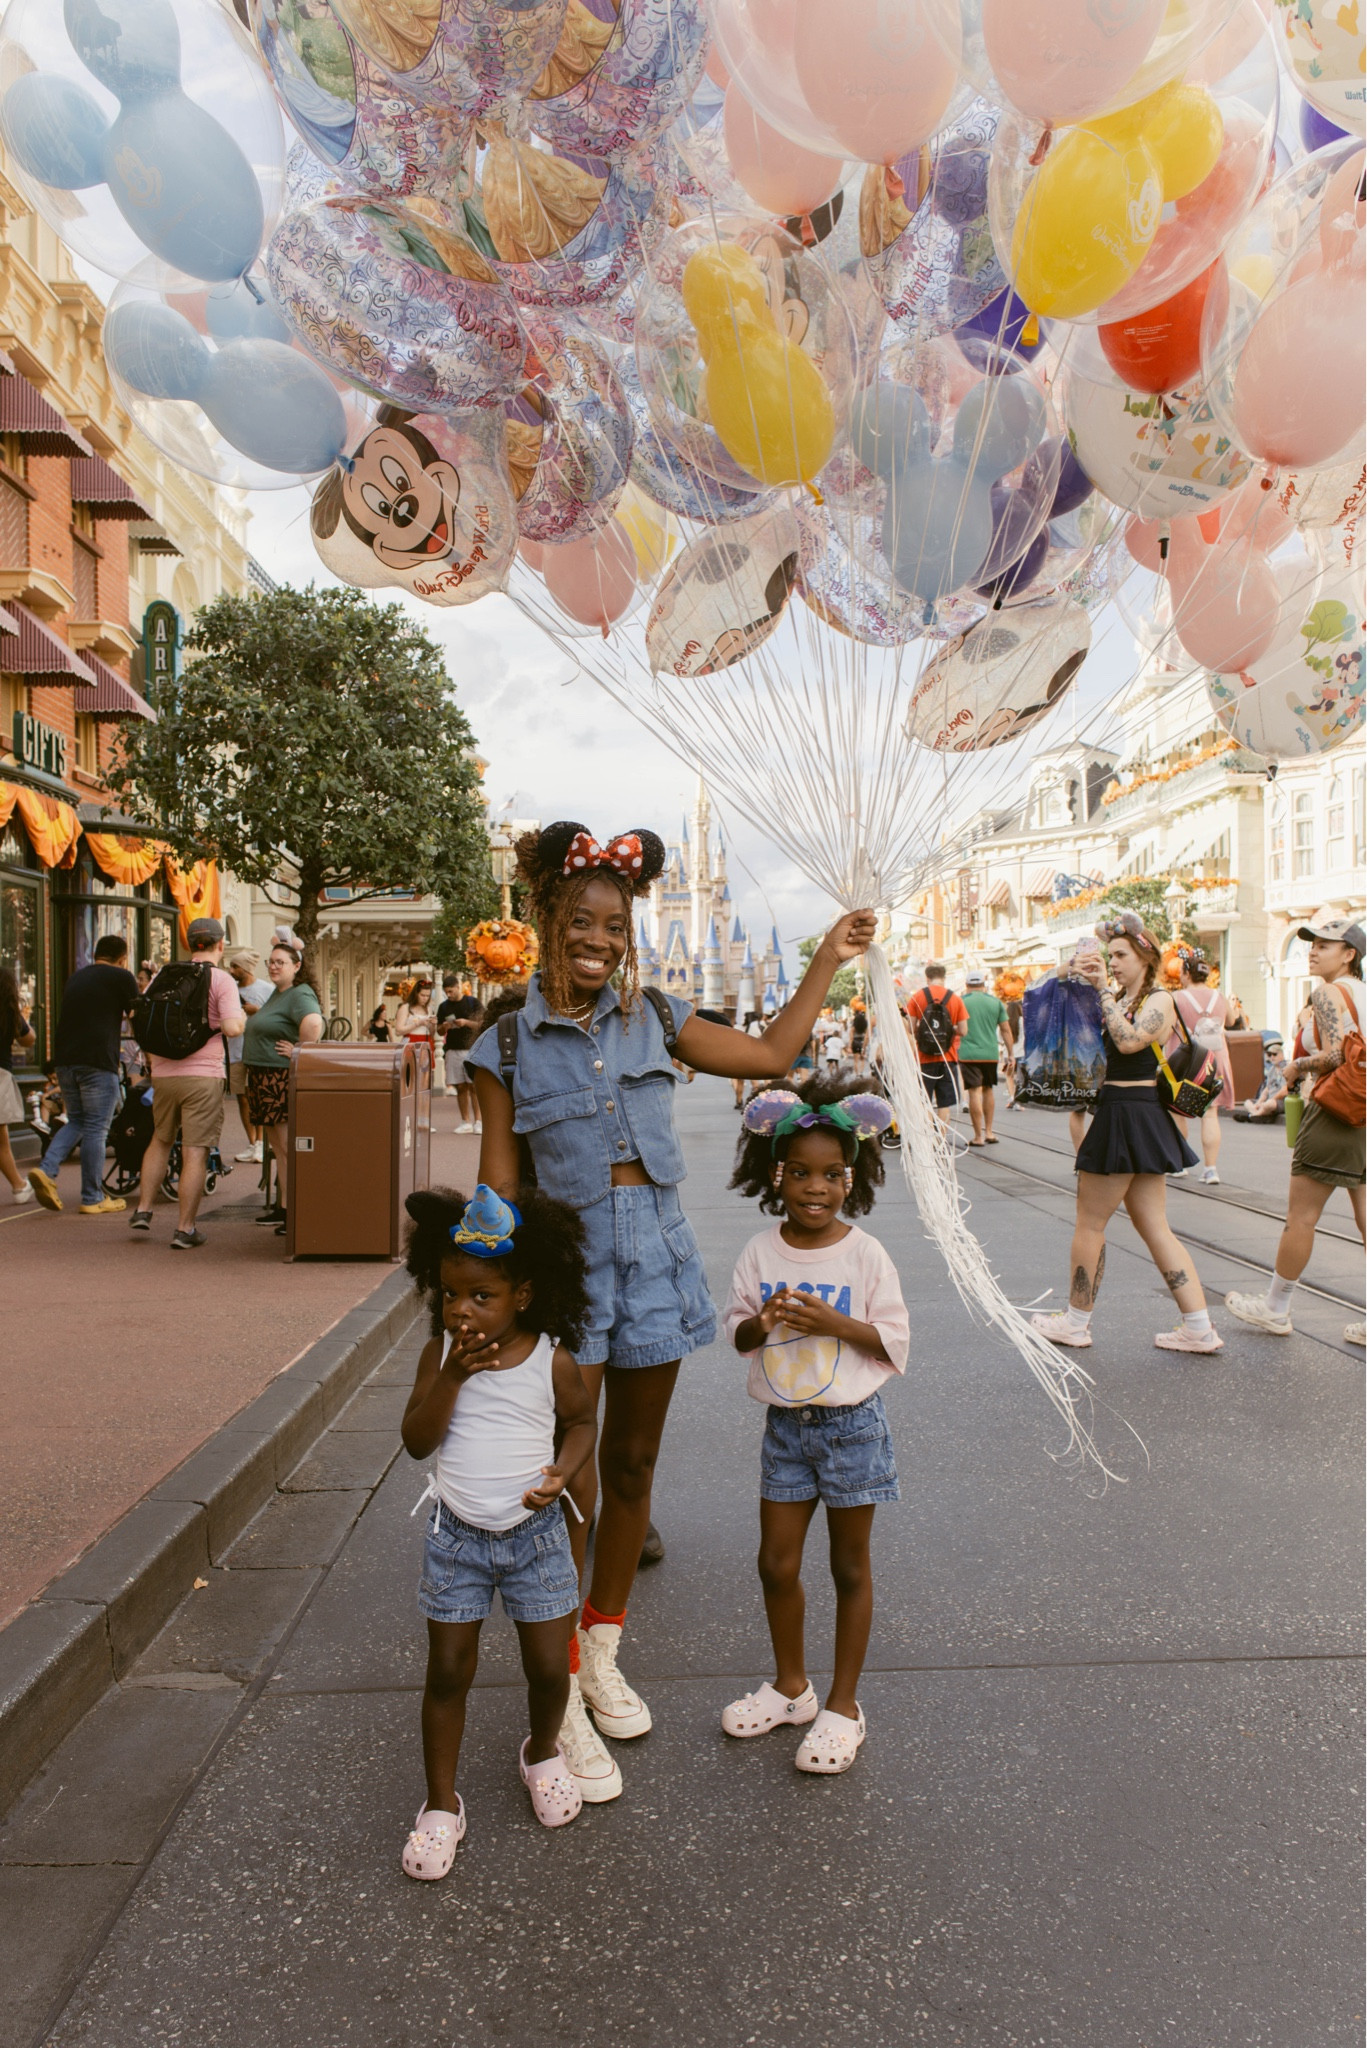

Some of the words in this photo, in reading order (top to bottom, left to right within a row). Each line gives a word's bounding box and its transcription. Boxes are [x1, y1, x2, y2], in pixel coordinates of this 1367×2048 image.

[413, 577, 446, 596] Walt
[435, 545, 489, 588] Disney
[472, 505, 490, 545] World
[23, 714, 68, 778] GIFTS
